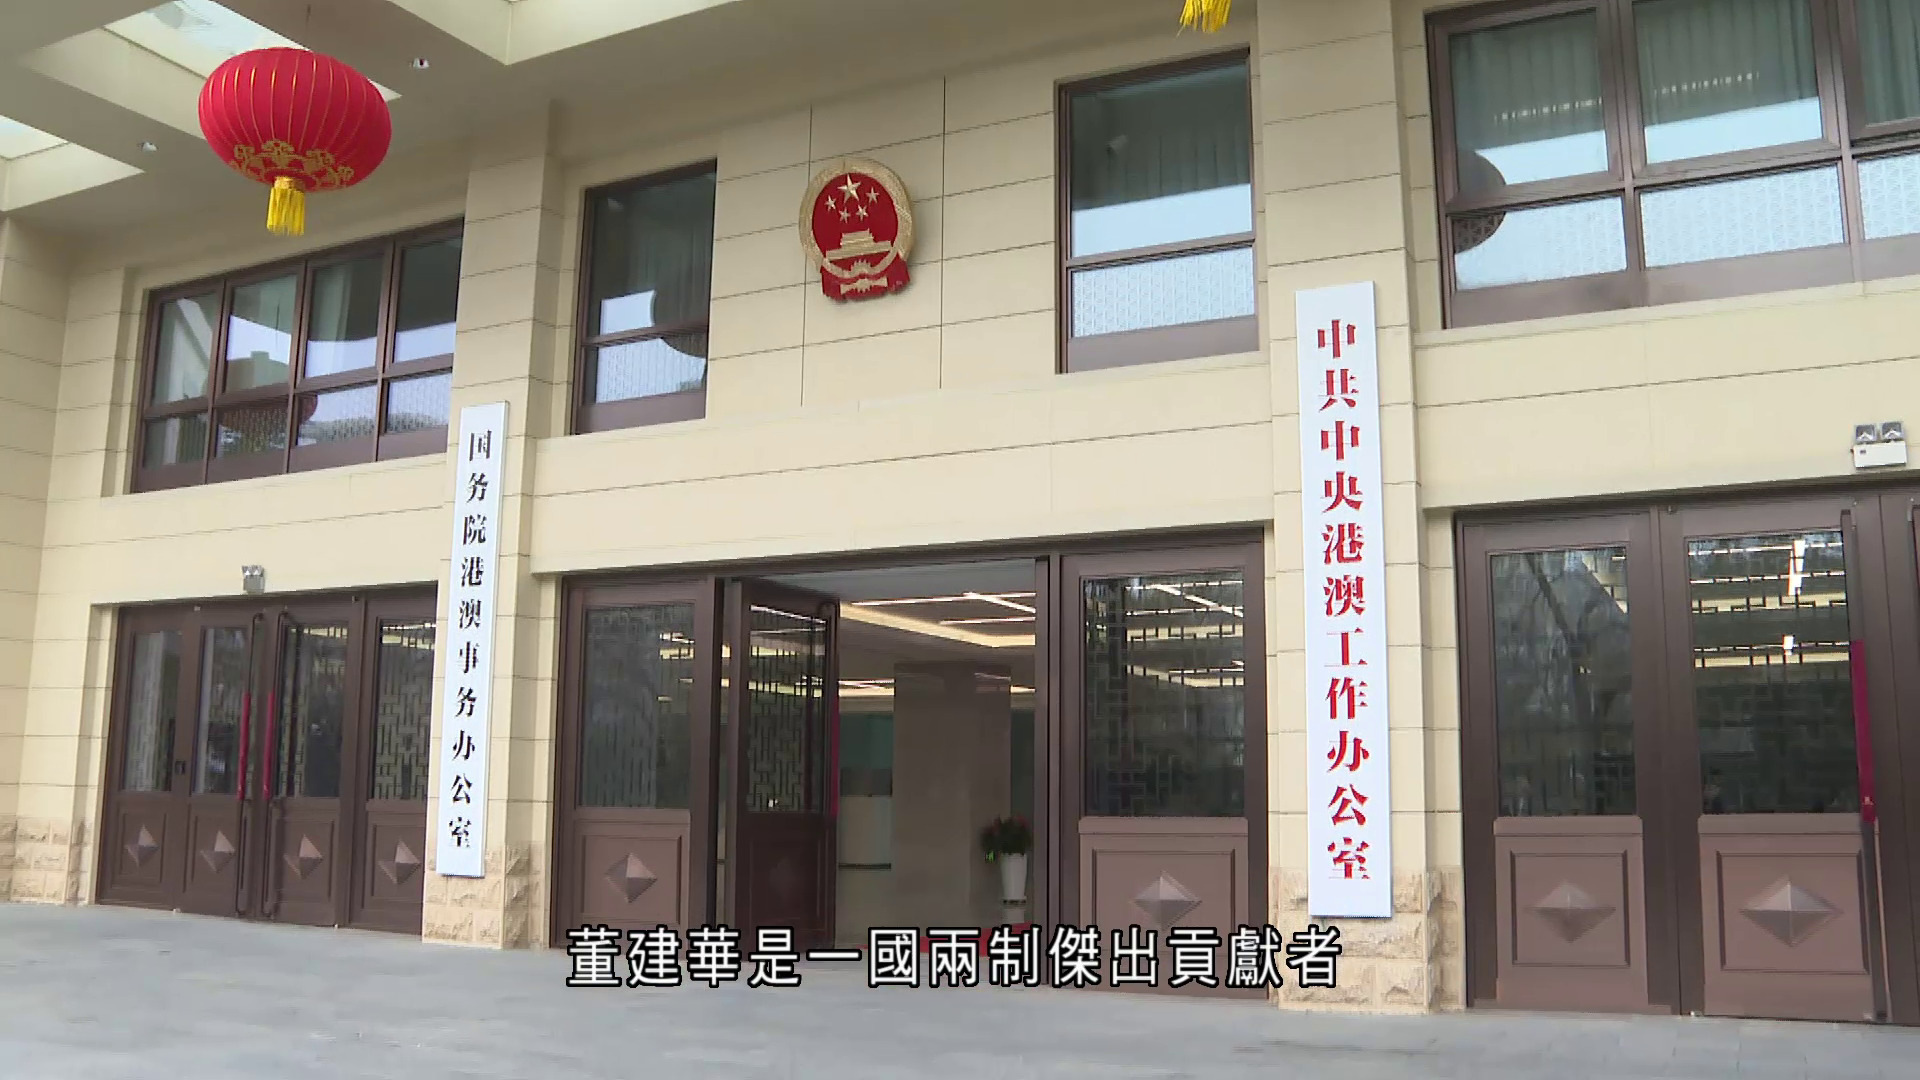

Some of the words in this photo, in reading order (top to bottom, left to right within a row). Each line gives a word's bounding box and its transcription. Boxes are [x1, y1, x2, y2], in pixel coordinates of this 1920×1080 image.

[448, 428, 492, 849] 国务院港澳事务办公室
[1317, 318, 1371, 880] 中共中央港澳工作办公室
